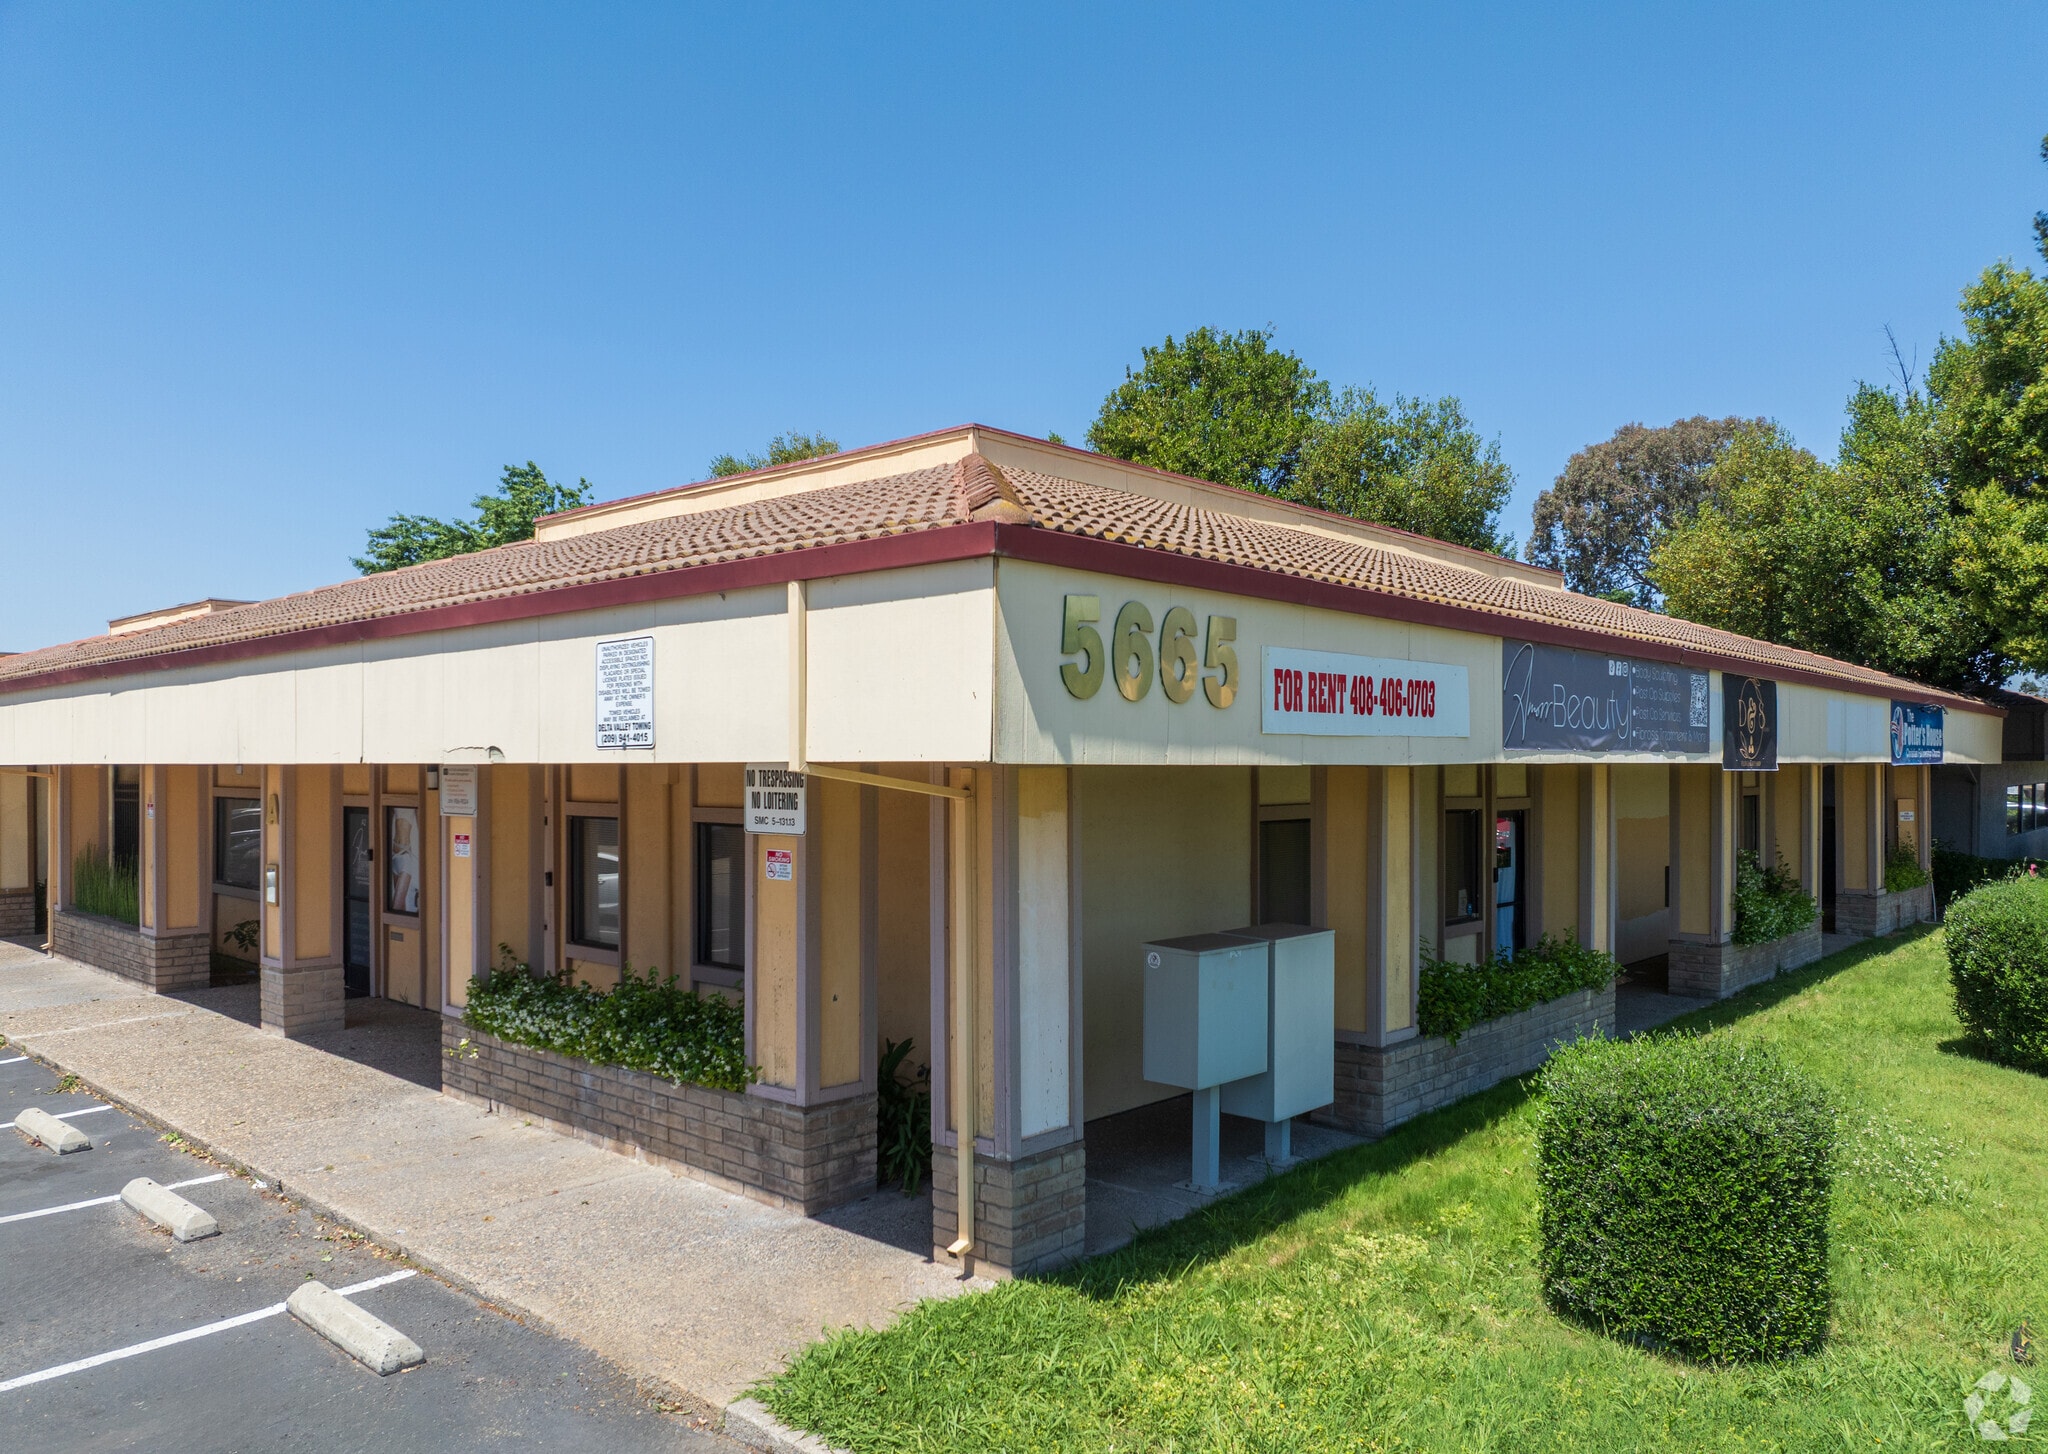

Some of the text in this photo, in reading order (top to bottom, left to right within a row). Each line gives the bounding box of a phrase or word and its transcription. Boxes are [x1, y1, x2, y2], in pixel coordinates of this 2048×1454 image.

[1059, 594, 1240, 709] 5665
[1636, 665, 1678, 685] Body Sculpting
[1274, 668, 1436, 718] FOR RENT 408-406-0703
[1636, 686, 1680, 703] Post Op Supplies
[1553, 684, 1629, 740] Beauty
[1636, 706, 1681, 722] Post Op Services
[1906, 708, 1914, 722] The
[598, 722, 651, 732] DELTA VALLEY TOWING
[1636, 727, 1658, 740] Fibrosis
[1904, 722, 1943, 746] Potter's House
[602, 732, 648, 744] (209) 941-4015
[746, 770, 804, 788] NO TRESPASSING
[752, 792, 798, 810] NO LOITERING
[754, 816, 768, 826] SMC
